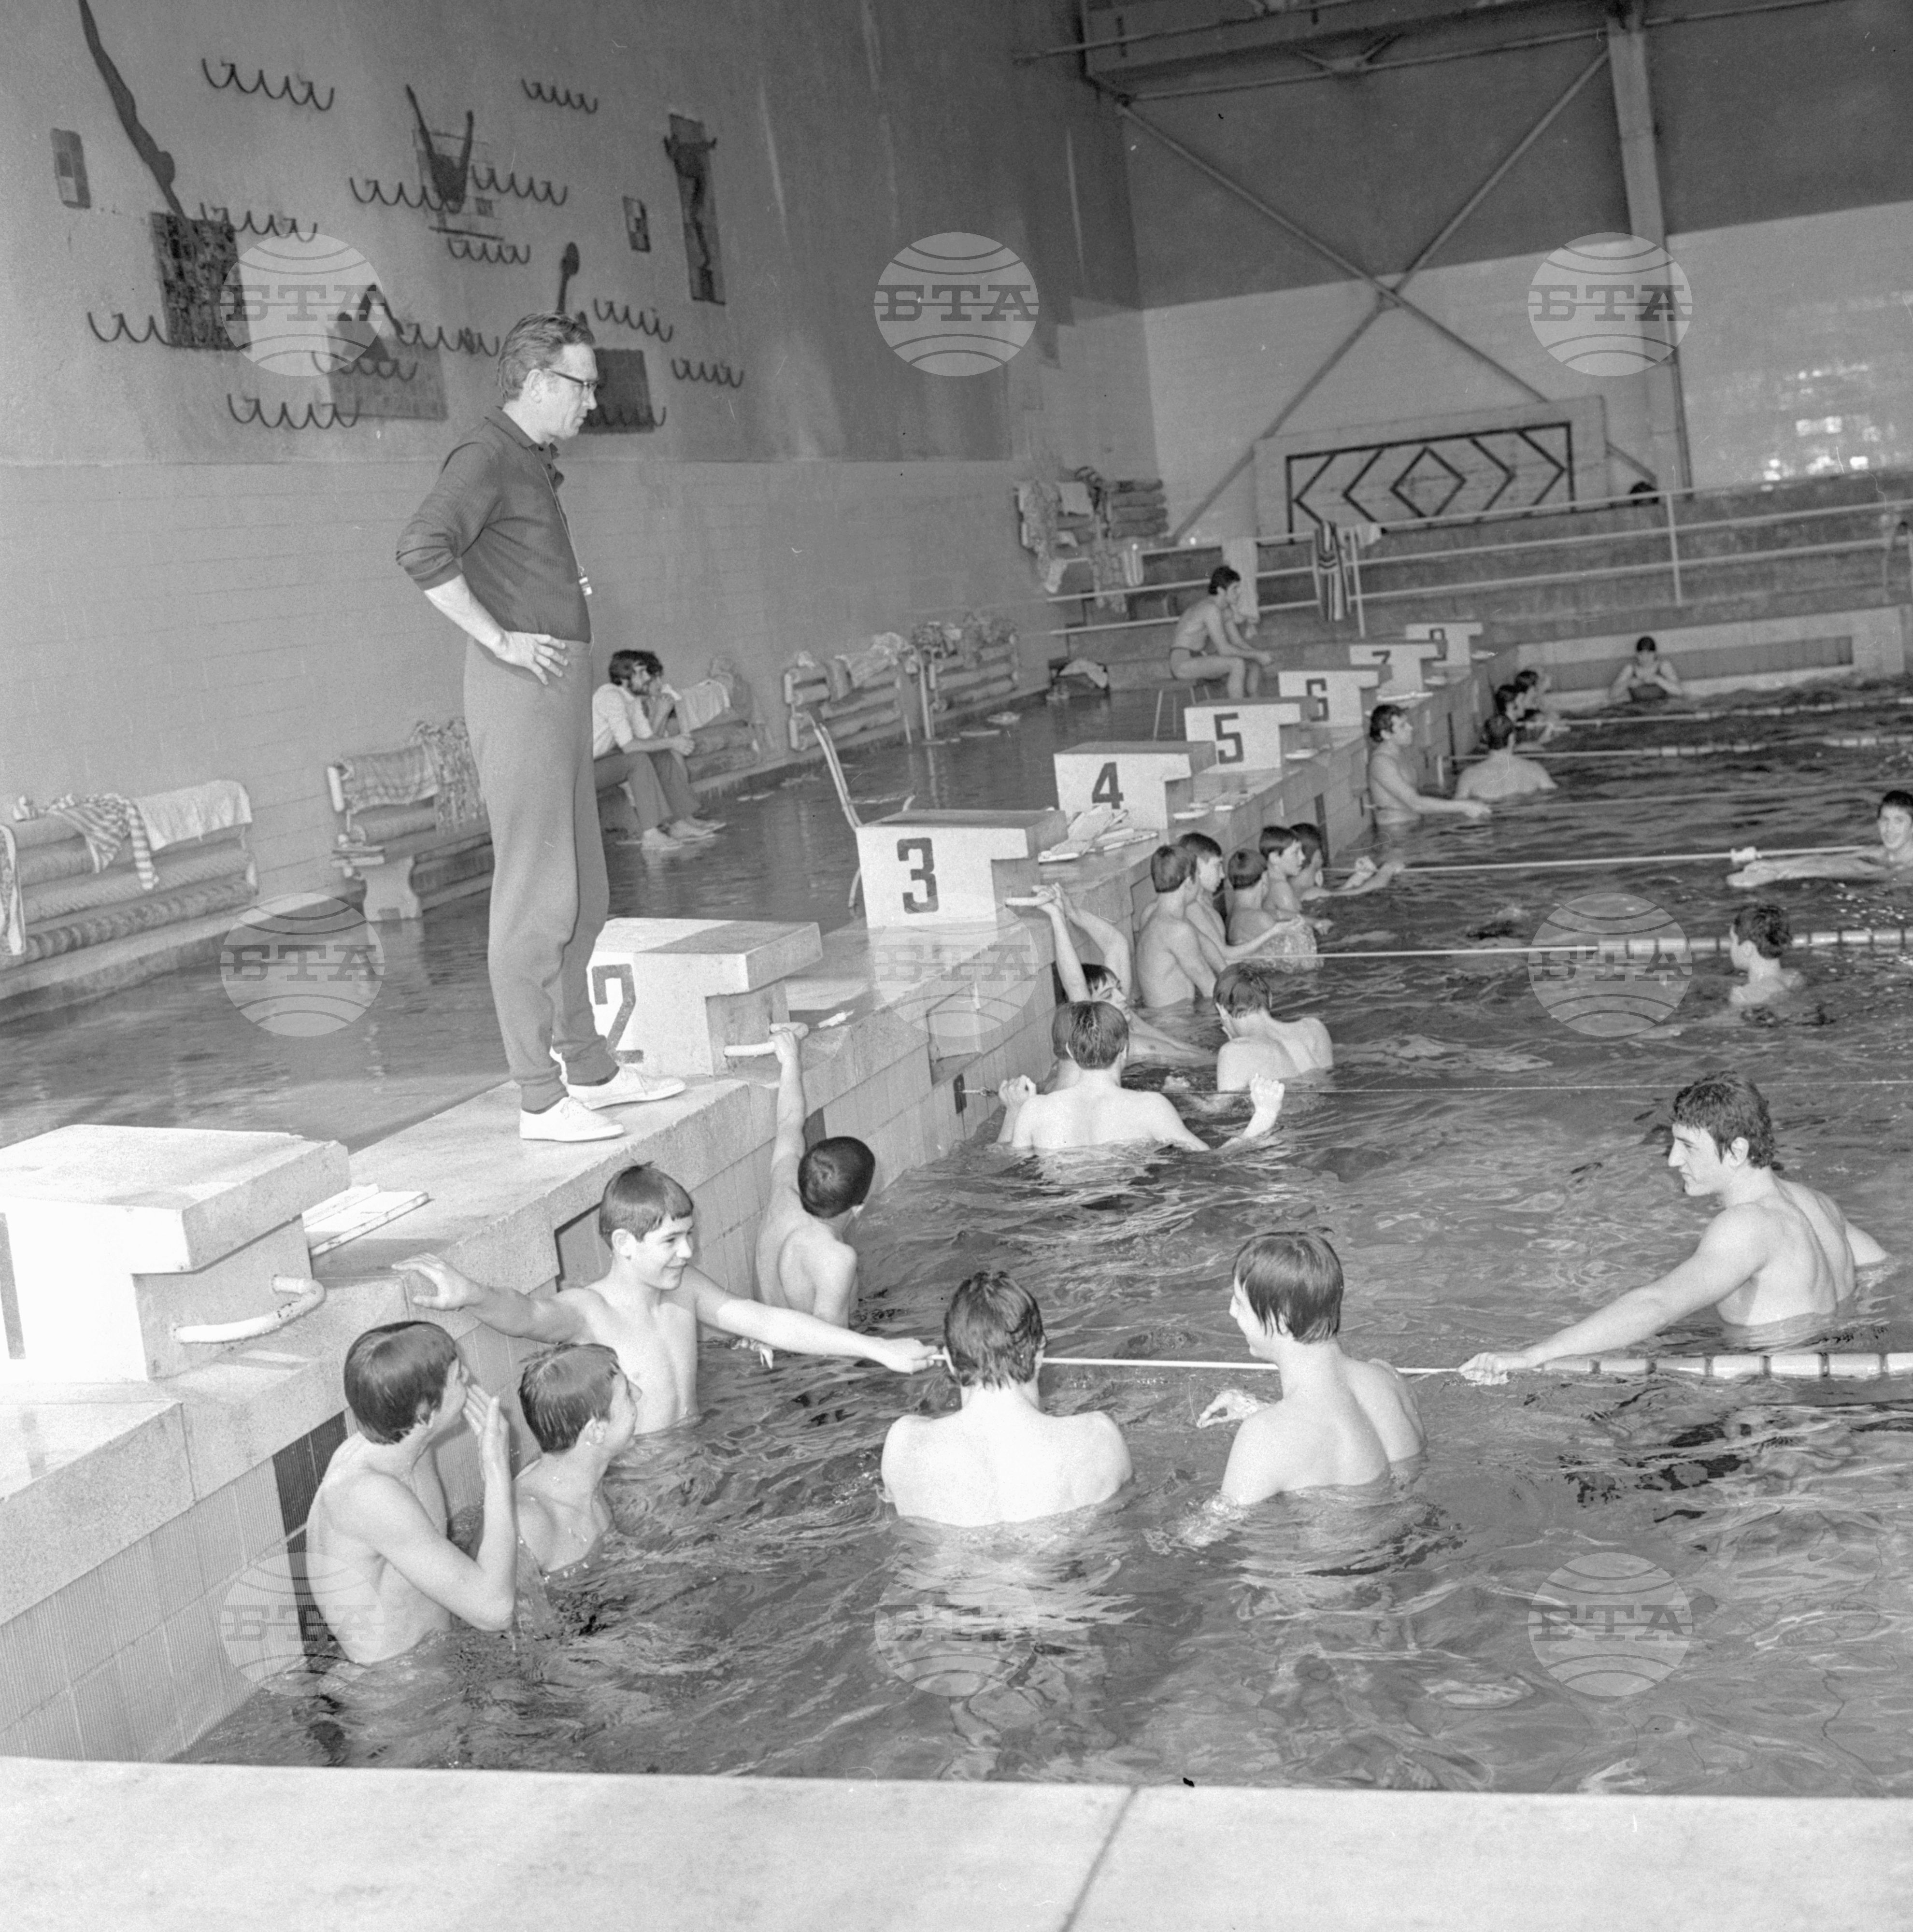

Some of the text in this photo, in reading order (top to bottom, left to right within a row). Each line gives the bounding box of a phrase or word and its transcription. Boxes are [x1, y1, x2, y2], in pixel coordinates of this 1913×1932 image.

[1306, 678, 1329, 722] 6
[1213, 712, 1243, 764] 5
[1091, 762, 1124, 810] 4
[897, 838, 939, 914] 3
[591, 964, 644, 1064] 2
